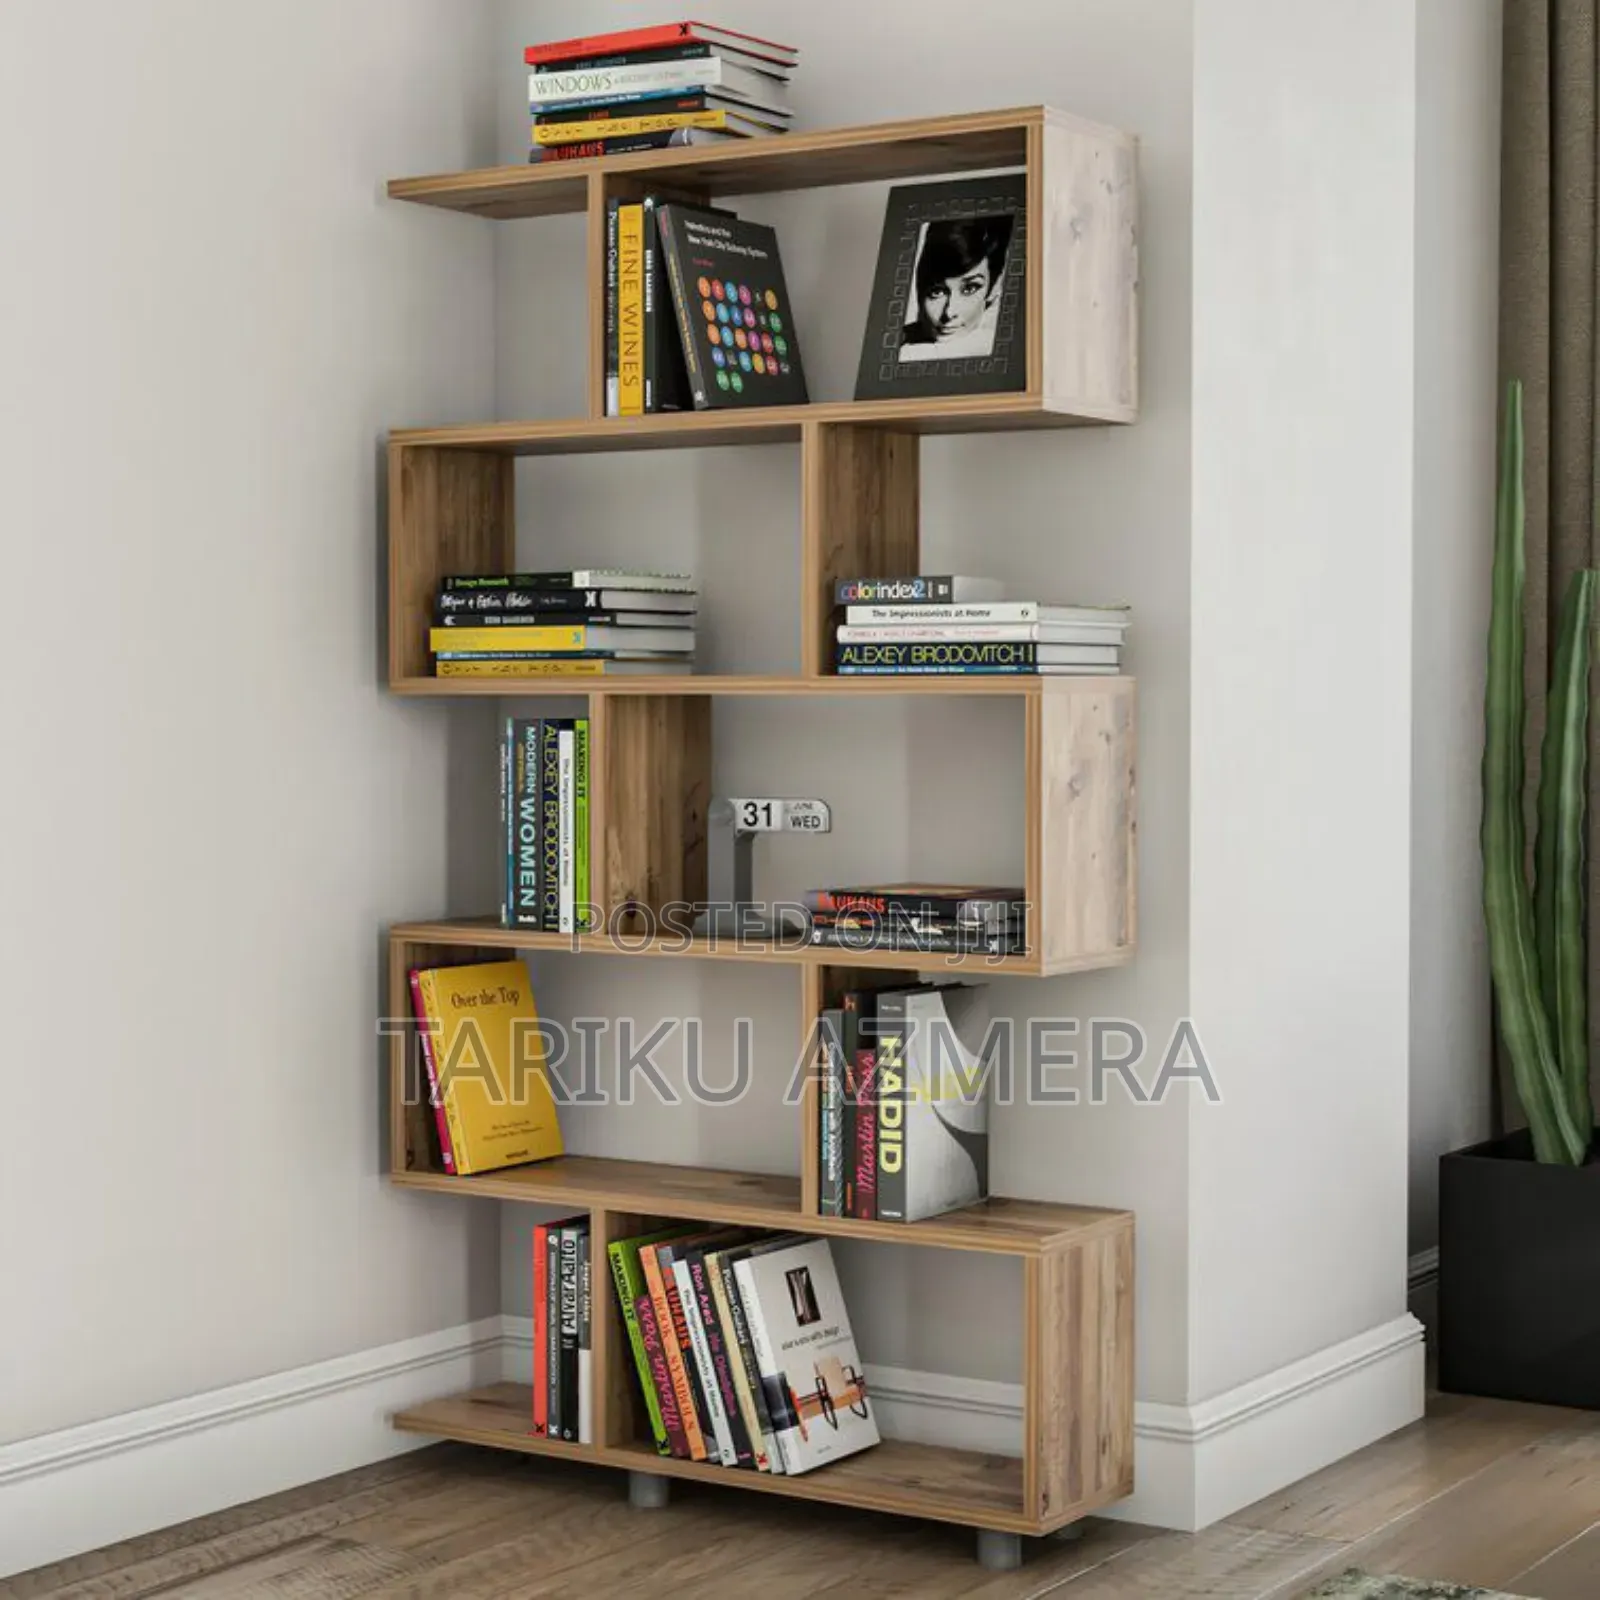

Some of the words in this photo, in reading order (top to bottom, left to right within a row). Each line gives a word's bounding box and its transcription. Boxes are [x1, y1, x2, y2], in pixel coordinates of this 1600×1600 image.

[534, 73, 613, 95] WINDOWS
[622, 232, 638, 290] FINE
[623, 302, 639, 386] WINES
[842, 646, 908, 664] ALEXEY
[911, 644, 1024, 664] BRODOVITCH
[526, 726, 537, 793] MODERN
[544, 724, 558, 795] ALEXEY
[577, 729, 586, 784] MAKING
[577, 786, 586, 798] IT
[743, 801, 772, 827] 31
[790, 815, 821, 828] WED
[520, 797, 535, 906] WOMEN
[544, 801, 558, 918] BRODOVITCH
[451, 991, 477, 1009] Over
[479, 988, 496, 1005] the
[498, 986, 520, 1007] Top
[880, 1037, 902, 1174] HADID
[857, 1114, 875, 1192] Martin
[562, 1240, 576, 1285] Aalto
[612, 1252, 631, 1303] MAKING
[625, 1308, 635, 1320] IT
[562, 1286, 576, 1329] Alvar
[691, 1264, 705, 1291] Ron
[700, 1294, 714, 1325] Arad
